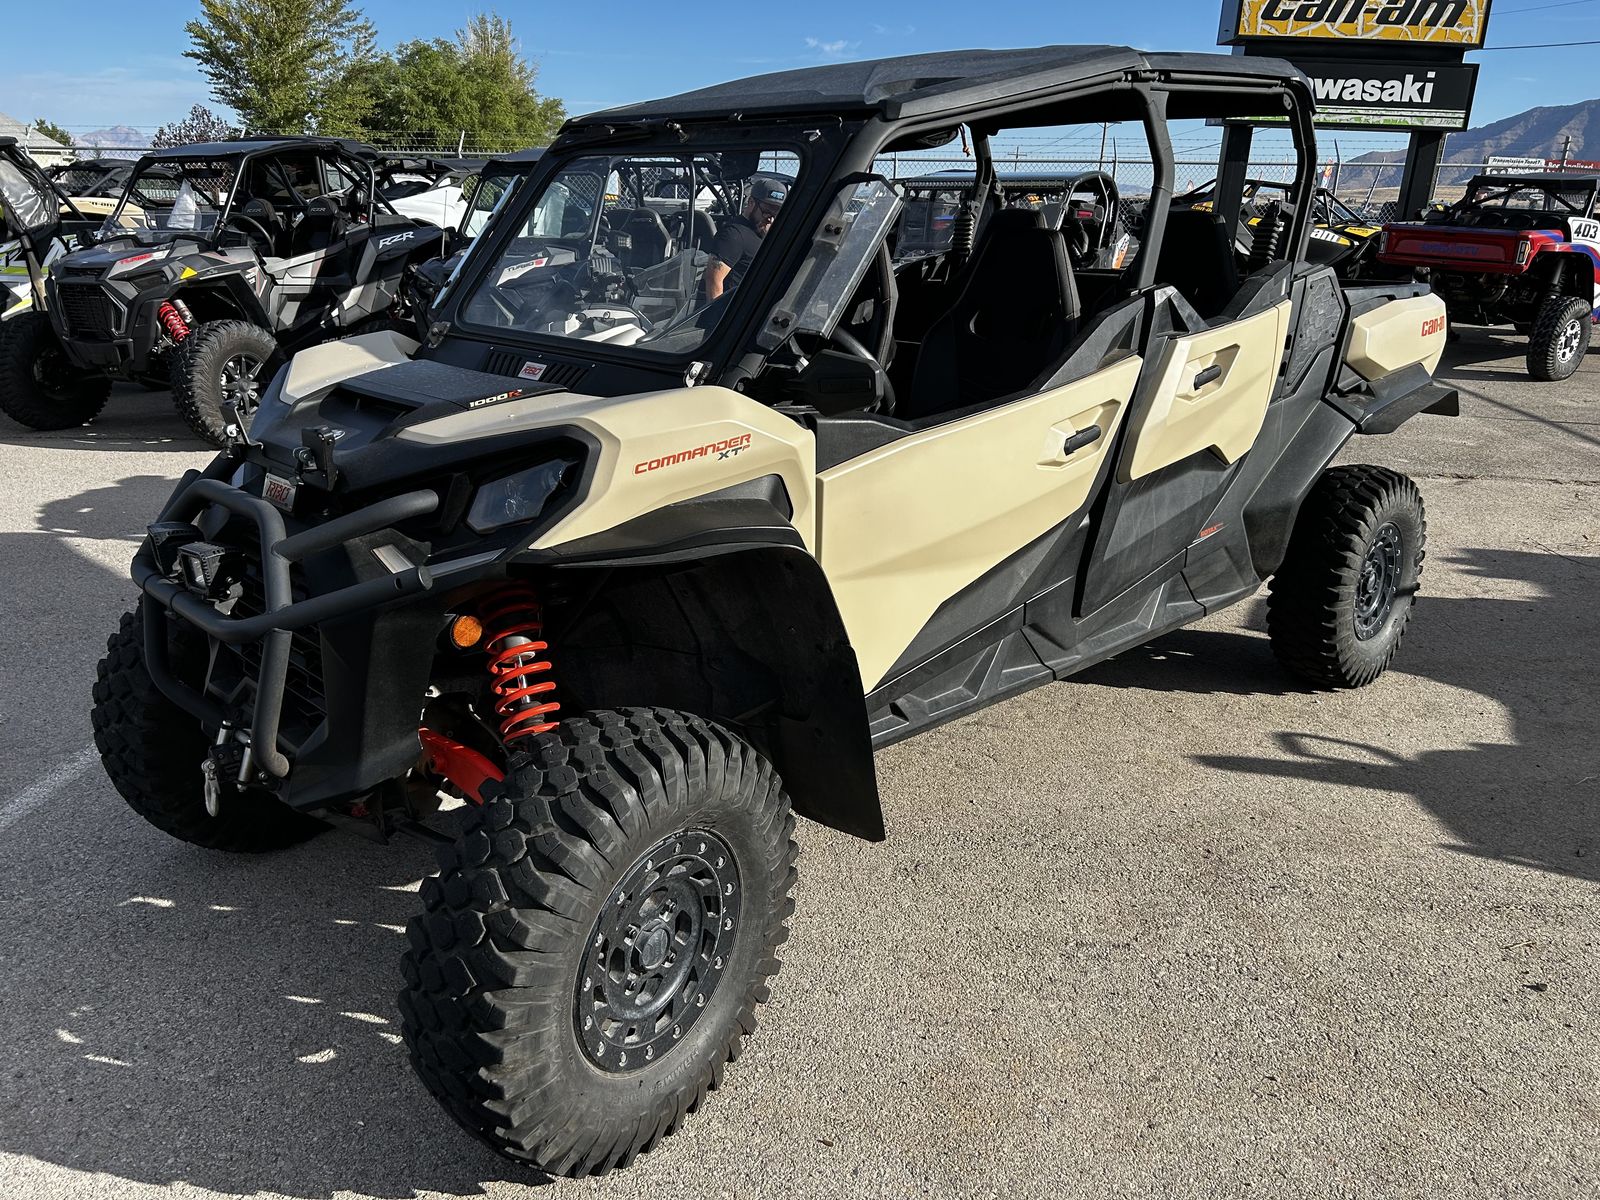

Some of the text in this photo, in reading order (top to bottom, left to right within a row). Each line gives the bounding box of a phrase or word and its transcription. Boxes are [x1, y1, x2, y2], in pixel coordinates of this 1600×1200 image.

[1307, 72, 1436, 103] wasaki
[379, 231, 415, 250] RZR
[469, 389, 523, 408] 1000R
[634, 433, 752, 475] COMMANDER
